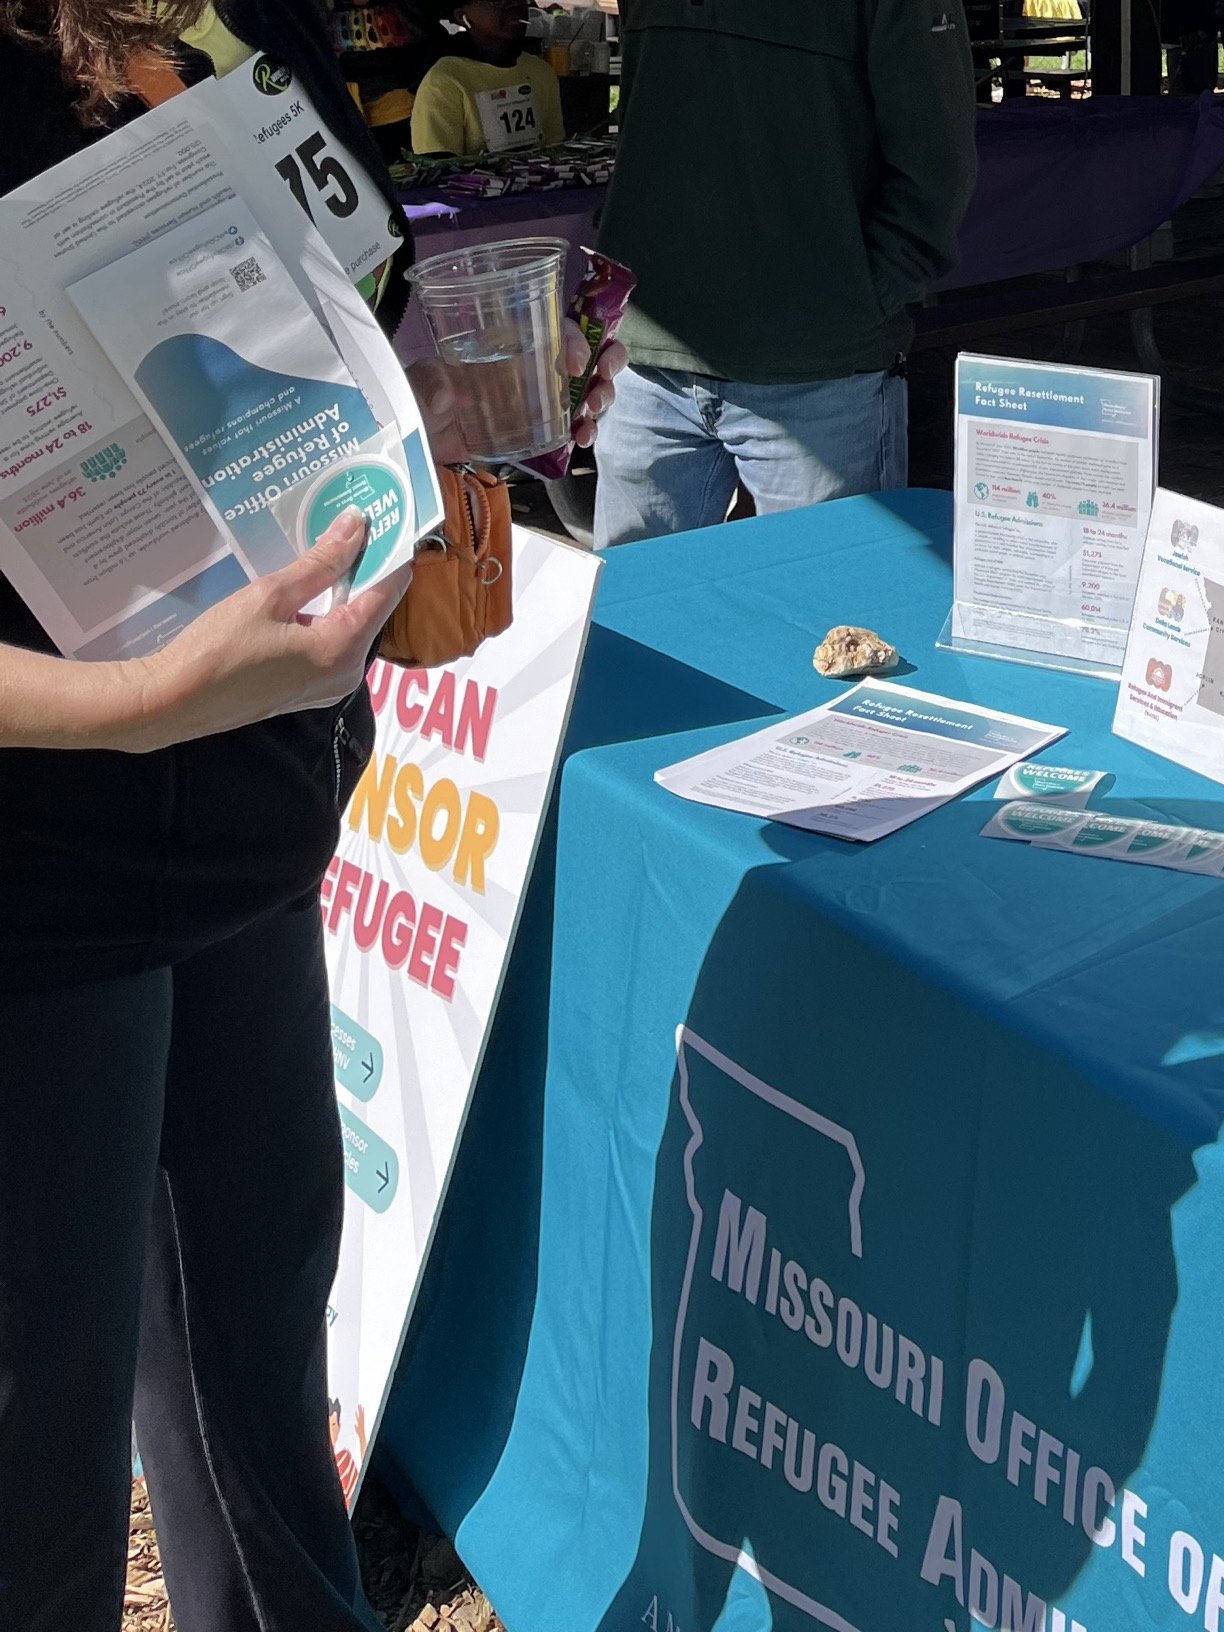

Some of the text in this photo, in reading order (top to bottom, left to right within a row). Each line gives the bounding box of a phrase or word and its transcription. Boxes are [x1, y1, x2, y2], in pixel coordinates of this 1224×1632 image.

[254, 101, 304, 144] efugees 5K
[500, 107, 535, 133] 124
[26, 386, 66, 417] $1,275
[226, 395, 275, 430] champions
[255, 400, 292, 427] Missouri
[975, 382, 1084, 404] Refugee Resettlement
[975, 396, 1027, 410] Fact Sheet
[0, 419, 91, 481] 18 to 24 months
[201, 404, 342, 488] Administration
[248, 421, 351, 483] of Refugee
[223, 437, 360, 525] Missouri Office
[14, 486, 85, 535] 36.4 million
[396, 668, 498, 764] CAN
[853, 706, 907, 723] Fact Sheet
[861, 699, 974, 731] Refugee Resettlement
[1022, 766, 1085, 784] WELCOME
[348, 751, 500, 897] NSOR
[322, 854, 468, 1004] EFUGEE
[711, 1188, 942, 1427] MISSOURI
[966, 1359, 1148, 1577] OFFICE
[691, 1336, 901, 1559] REFUGEE
